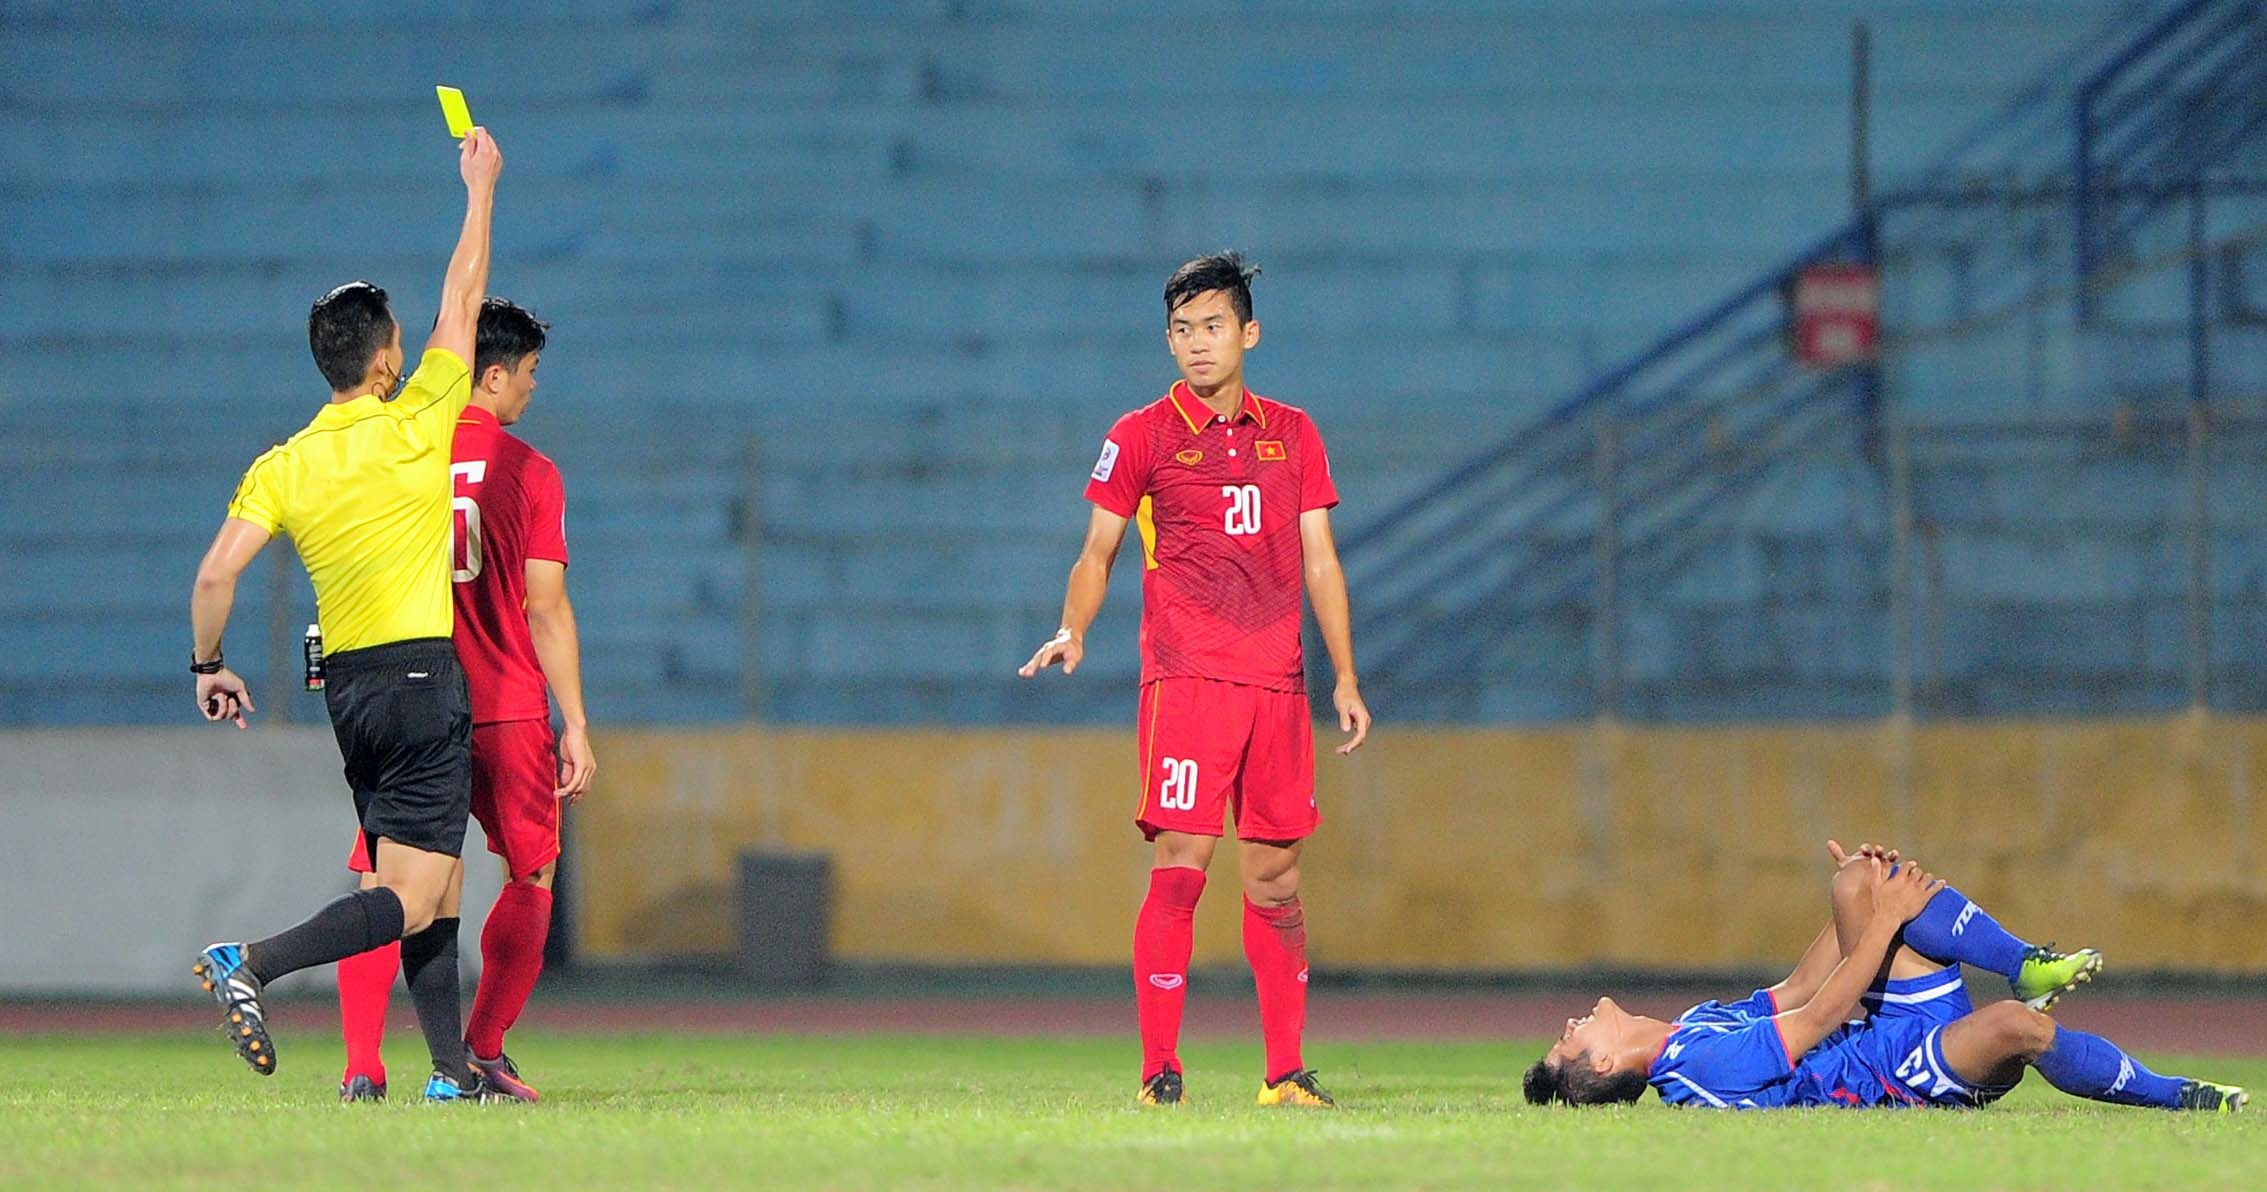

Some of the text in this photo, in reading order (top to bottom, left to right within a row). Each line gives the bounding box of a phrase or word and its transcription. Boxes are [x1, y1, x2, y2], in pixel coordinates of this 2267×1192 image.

[1221, 484, 1262, 536] 20
[1160, 756, 1199, 811] 20
[1895, 1044, 1931, 1088] 13
